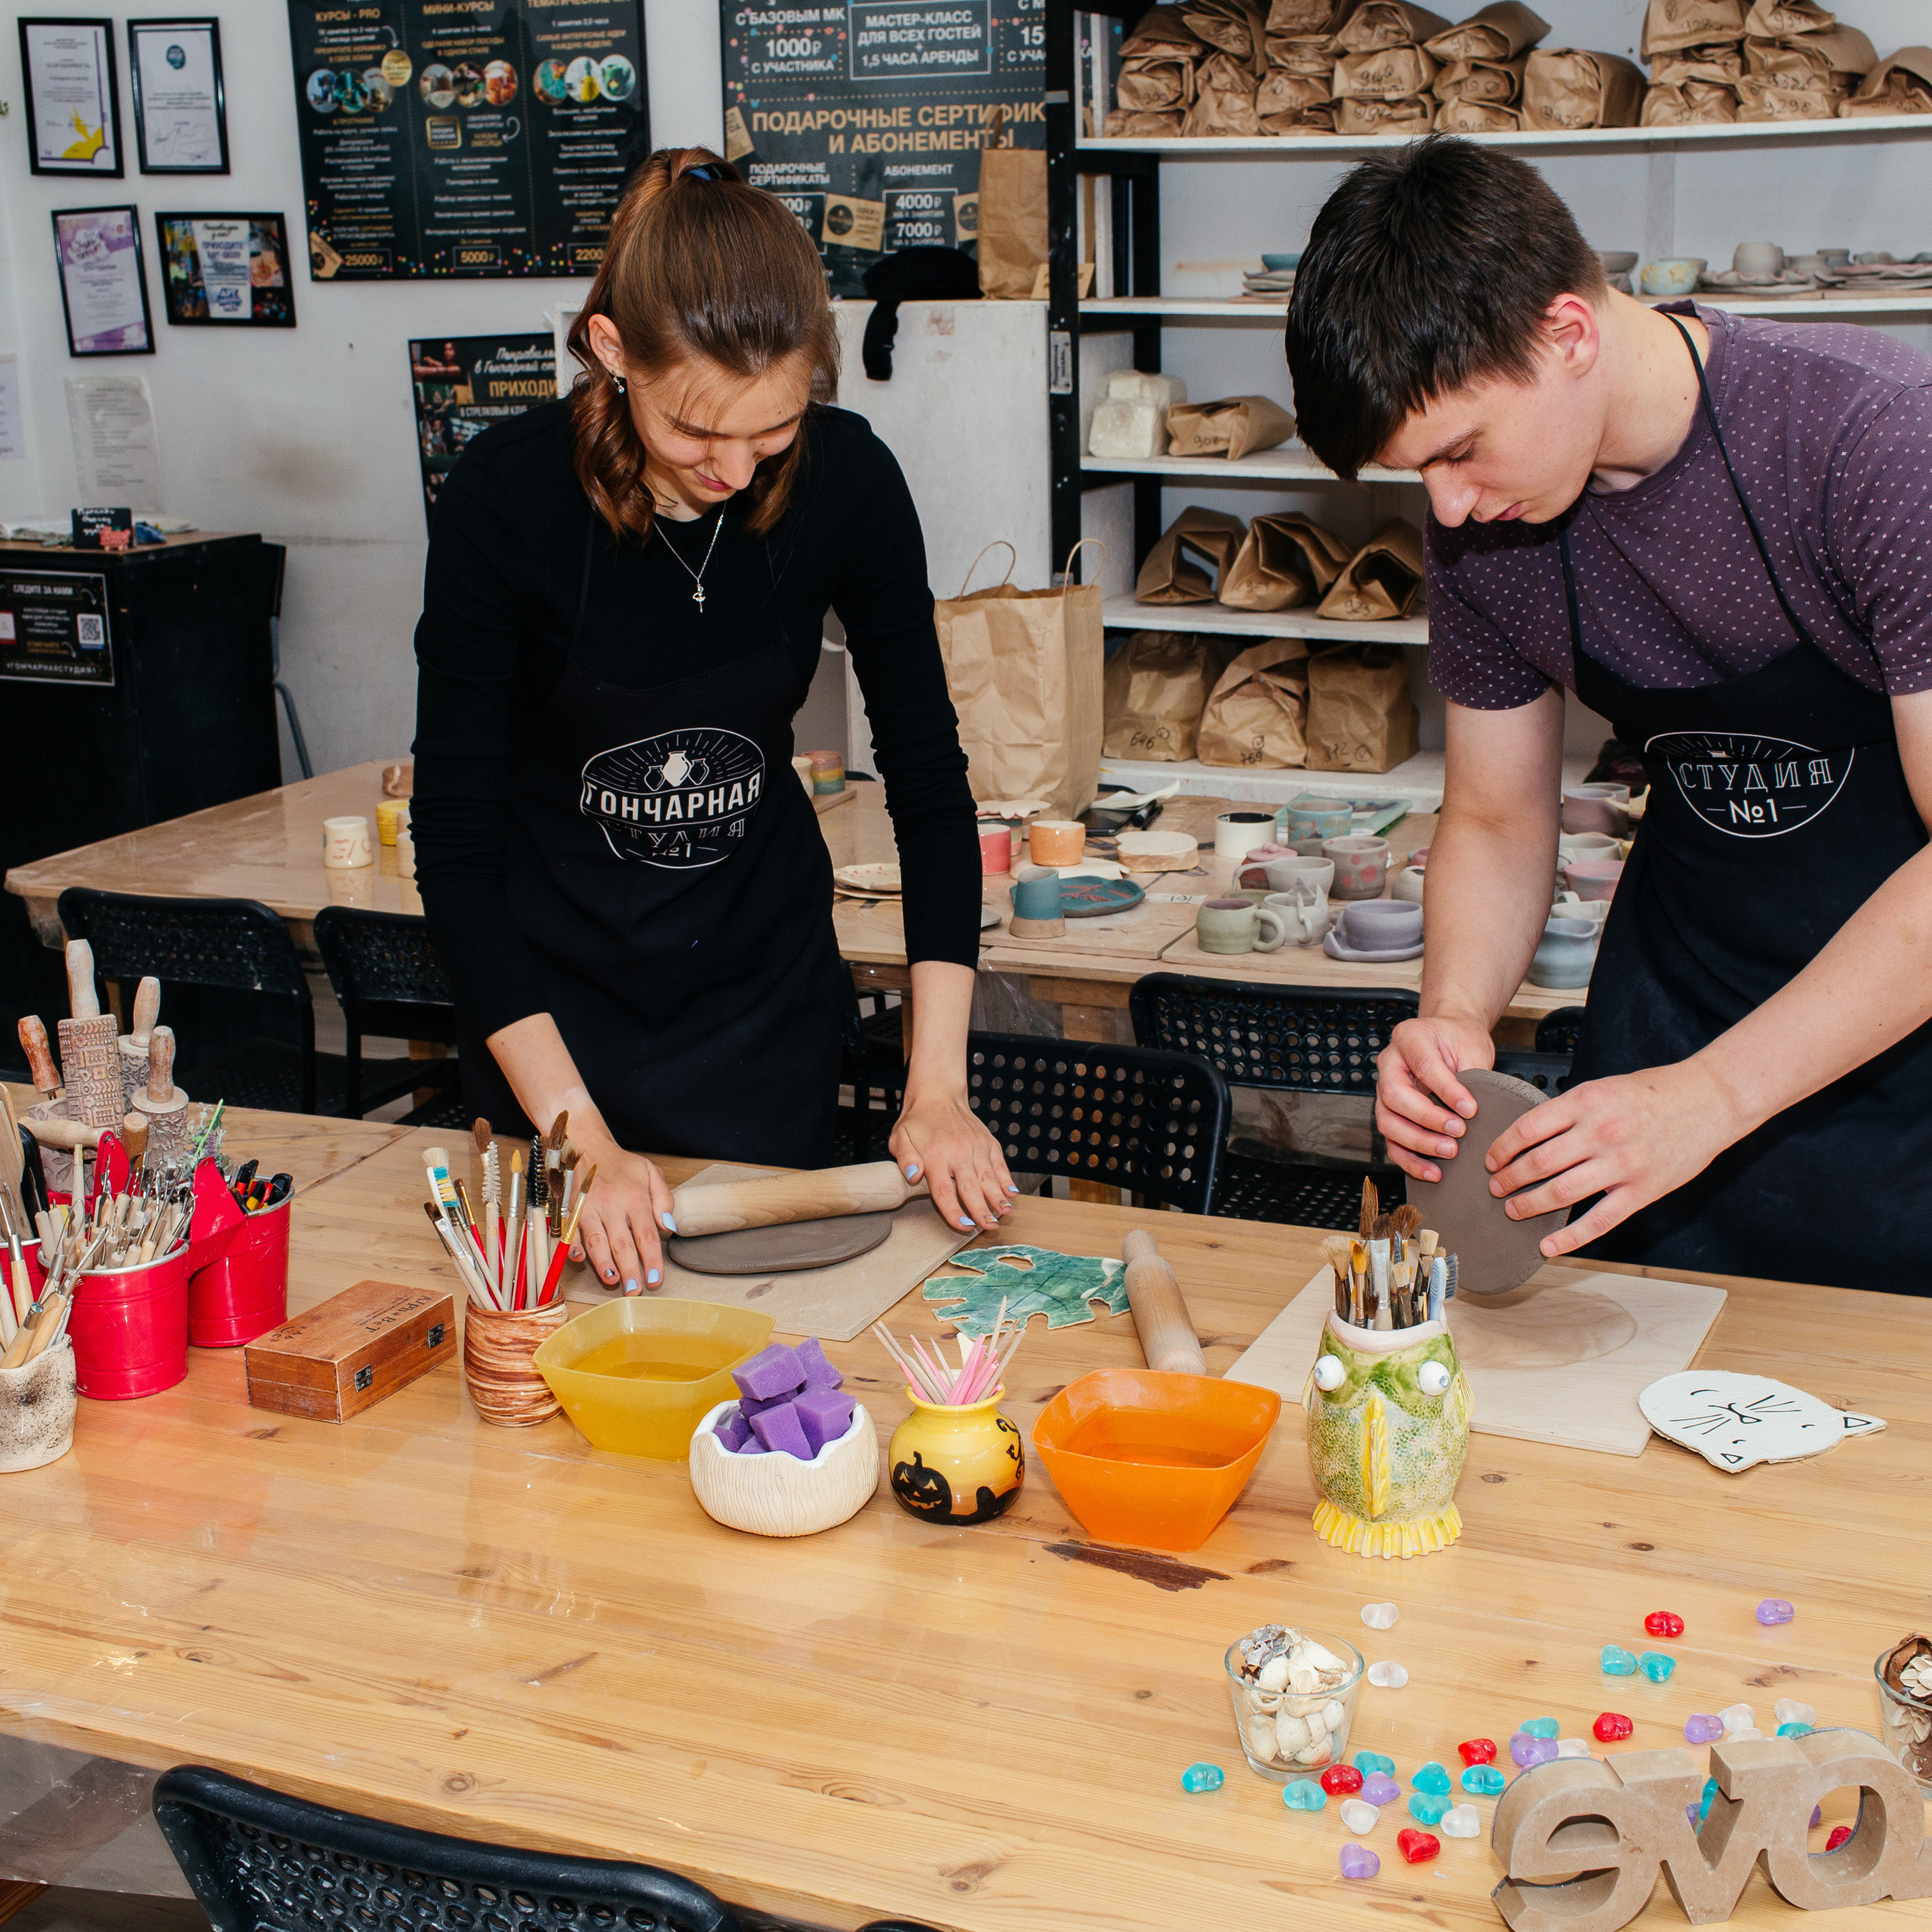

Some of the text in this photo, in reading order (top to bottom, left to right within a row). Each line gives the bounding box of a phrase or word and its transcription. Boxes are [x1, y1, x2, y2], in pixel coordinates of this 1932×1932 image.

[315, 11, 351, 22] КУРСЫ
[358, 8, 381, 20] PRO
[423, 1, 494, 14] МИНИ-КУРСЫ
[735, 8, 846, 26] С БАЗОВЫМ МК
[865, 10, 973, 28] МАСТЕР-КЛАСС
[857, 24, 982, 48] ДЛЯ ВСЕХ ГОСТЕЙ
[751, 60, 835, 74] С УЧАСТНИКА
[861, 48, 980, 69] 1,5 ЧАСА АРЕНДЫ
[752, 106, 912, 135] ПОДАРОЧНЫЕ
[829, 134, 844, 154] И
[749, 162, 826, 175] ПОДАРОЧНЫЕ
[884, 163, 954, 177] АБОНЕМЕНТ
[748, 174, 830, 186] СЕРТИФИКАТЫ
[1679, 758, 1834, 794] СТУДИЯ
[585, 771, 761, 822] ГОНЧАРНАЯ
[1729, 798, 1778, 824] №1
